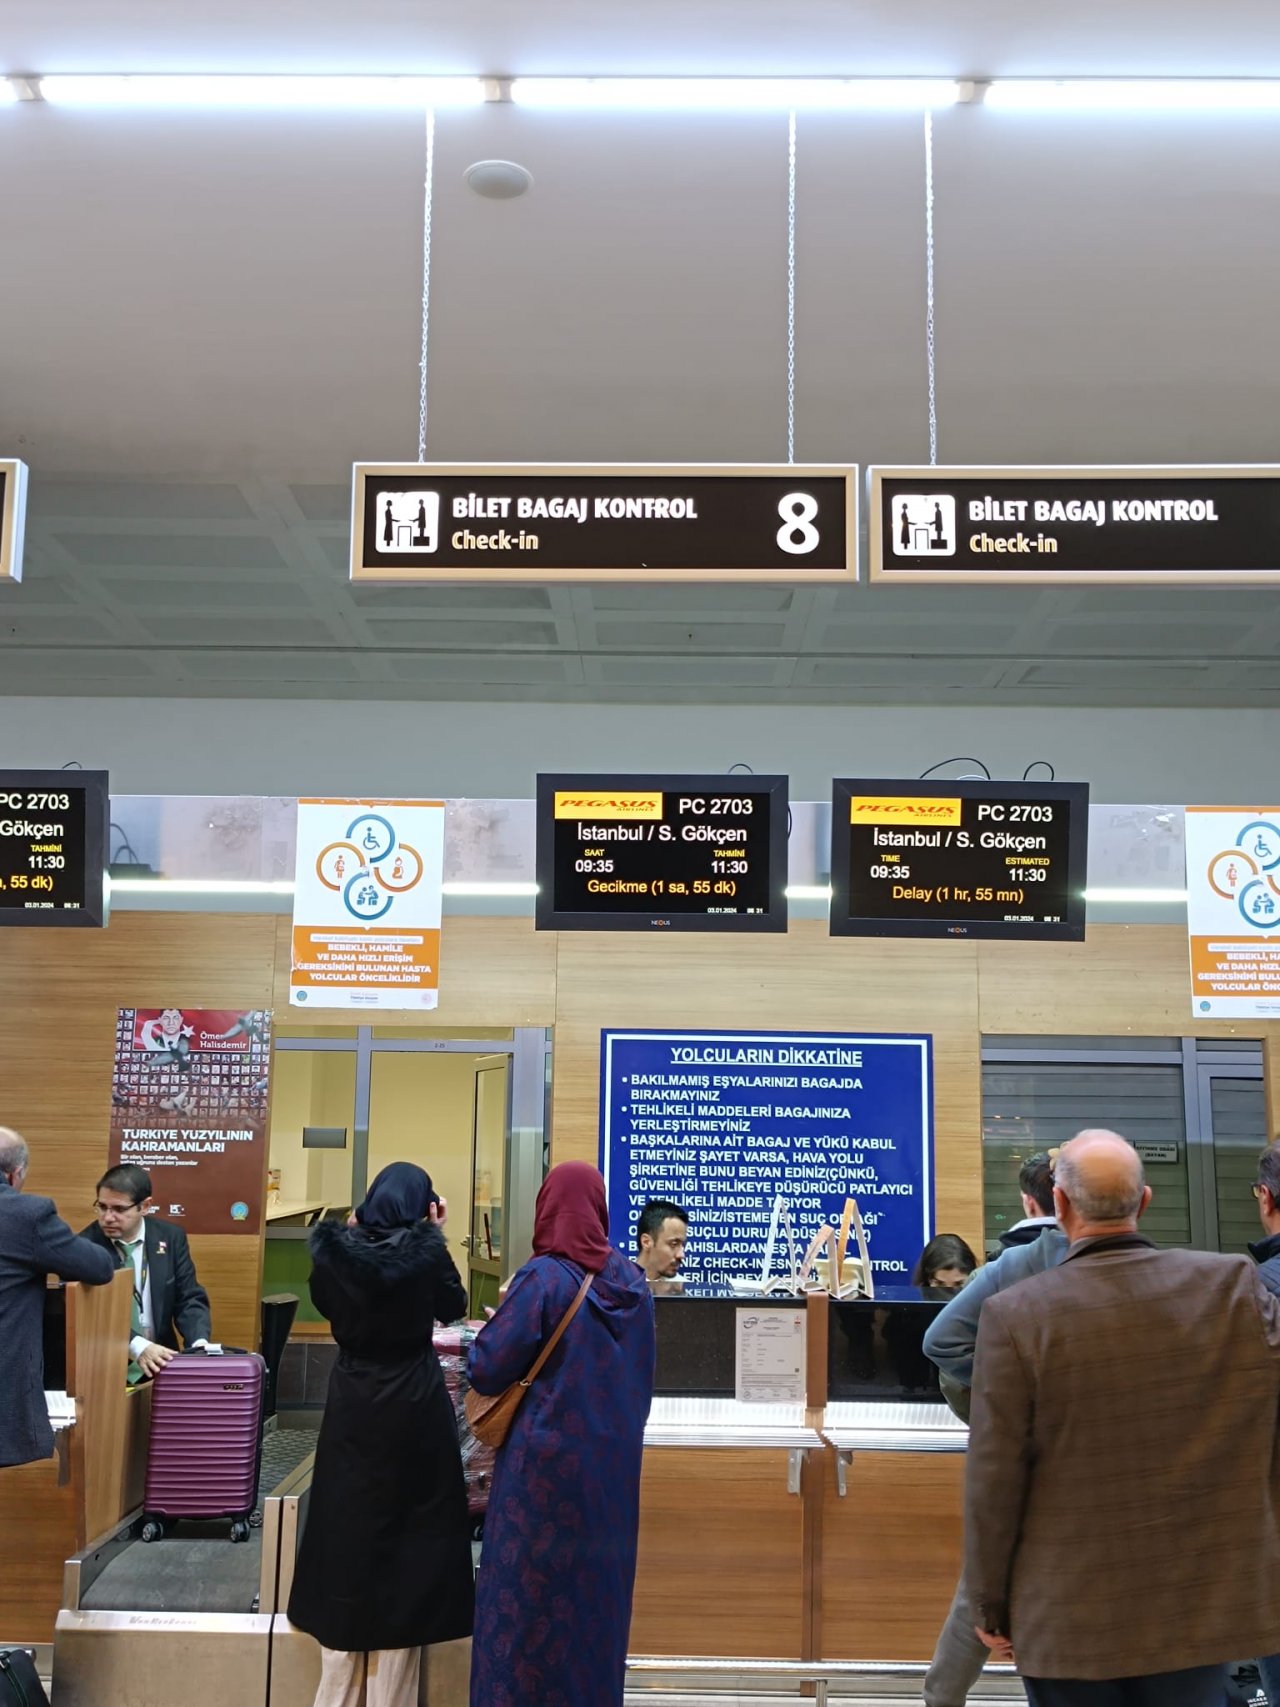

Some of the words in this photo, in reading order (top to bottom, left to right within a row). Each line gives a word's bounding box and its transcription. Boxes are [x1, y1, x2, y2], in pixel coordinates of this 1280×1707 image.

[452, 492, 511, 519] BİLET
[517, 498, 587, 524] BAGAJ
[594, 498, 697, 519] KONTROL
[969, 496, 1028, 521] BİLET
[1034, 501, 1105, 526] BAGAJ
[1112, 500, 1218, 521] KONTROL
[776, 492, 820, 554] 8
[452, 530, 538, 550] Check-in
[969, 532, 1057, 553] Check-in
[27, 793, 70, 810] 2703
[560, 800, 658, 808] PEGASUS
[679, 799, 705, 814] PC
[710, 799, 753, 815] 2703
[856, 805, 956, 814] PEGASUS
[978, 805, 1005, 821] PC
[1009, 805, 1053, 822] 2703
[0, 820, 64, 840] Gökçen
[577, 822, 643, 841] İstanbul
[647, 825, 654, 841] /
[658, 825, 676, 841] S.
[682, 825, 747, 844] Gökçen
[873, 827, 940, 847] İstanbul
[945, 831, 952, 847] /
[956, 832, 974, 848] S.
[980, 832, 1046, 852] Gökçen
[584, 849, 605, 857] SAAT
[881, 855, 900, 863] TIME
[28, 855, 65, 869] 11:30
[575, 860, 614, 873] 09:35
[712, 861, 748, 874] 11:30
[1005, 857, 1050, 866] ESTIMATED
[870, 865, 910, 879] 09:35
[1009, 868, 1046, 882] 11:30
[10, 875, 28, 888] 55
[31, 875, 53, 891] dk)
[588, 880, 647, 893] Gecikme
[651, 880, 664, 896] (1
[668, 884, 689, 895] sa,
[693, 881, 711, 893] 55
[714, 881, 736, 896] dk)
[892, 886, 933, 903] Delay
[936, 887, 949, 903] (1
[954, 888, 971, 902] hr,
[975, 888, 993, 900] 55
[997, 888, 1024, 904] mn)
[317, 953, 330, 961] VE
[383, 954, 413, 963] ERİŞİM
[356, 963, 400, 972] BULUNAN
[401, 964, 431, 973] HASTA
[310, 972, 357, 981] YOLCULAR
[1211, 982, 1261, 991] YOLCULAR
[200, 1040, 247, 1049] Halisdemir
[671, 1047, 773, 1063] YOLCULARIN
[778, 1047, 862, 1064] DİKKATİNE
[631, 1074, 710, 1088] BAKILMAMIŞ
[713, 1075, 798, 1088] EŞYALARINIZI
[801, 1077, 863, 1089] BAGAJDA
[631, 1089, 720, 1101] BIRAKMAYINIZ
[630, 1102, 694, 1116] TEHLİKELİ
[698, 1104, 771, 1117] MADDELERİ
[775, 1106, 851, 1119] BAGAJINIZA
[630, 1118, 751, 1133] YERLEŞTİRMEYİNİZ
[121, 1141, 225, 1152] KAHRAMANLARI
[630, 1134, 721, 1147] BAŞKALARINA
[723, 1133, 744, 1146] AİT
[747, 1136, 790, 1148] BAGAJ
[794, 1137, 810, 1148] VE
[813, 1136, 849, 1149] YÜKÜ
[852, 1138, 896, 1149] KABUL
[630, 1148, 696, 1160] ETMEYİNİZ
[699, 1150, 740, 1163] ŞAYET
[743, 1151, 789, 1164] VARSA,
[792, 1152, 827, 1163] HAVA
[829, 1152, 864, 1164] YOLU
[629, 1162, 696, 1177] ŞİRKETİNE
[699, 1166, 735, 1177] BUNU
[739, 1166, 781, 1177] BEYAN
[784, 1165, 878, 1181] EDİNİZ(ÇÜNKÜ,
[629, 1178, 698, 1191] GÜVENLİĞİ
[701, 1179, 771, 1193] TEHLİKEYE
[775, 1180, 846, 1195] DÜŞÜRÜCÜ
[850, 1183, 913, 1195] PATLAYICI
[629, 1195, 646, 1206] VE
[717, 1197, 763, 1208] MADDE
[766, 1197, 821, 1209] TŞIYOR
[800, 1213, 826, 1226] SUÇ
[829, 1211, 877, 1225] OAĞI
[686, 1226, 728, 1239] SUÇLU
[732, 1228, 788, 1239] DURUA
[684, 1242, 767, 1254] AHISLARDAN
[704, 1257, 763, 1269] CHECK-IN
